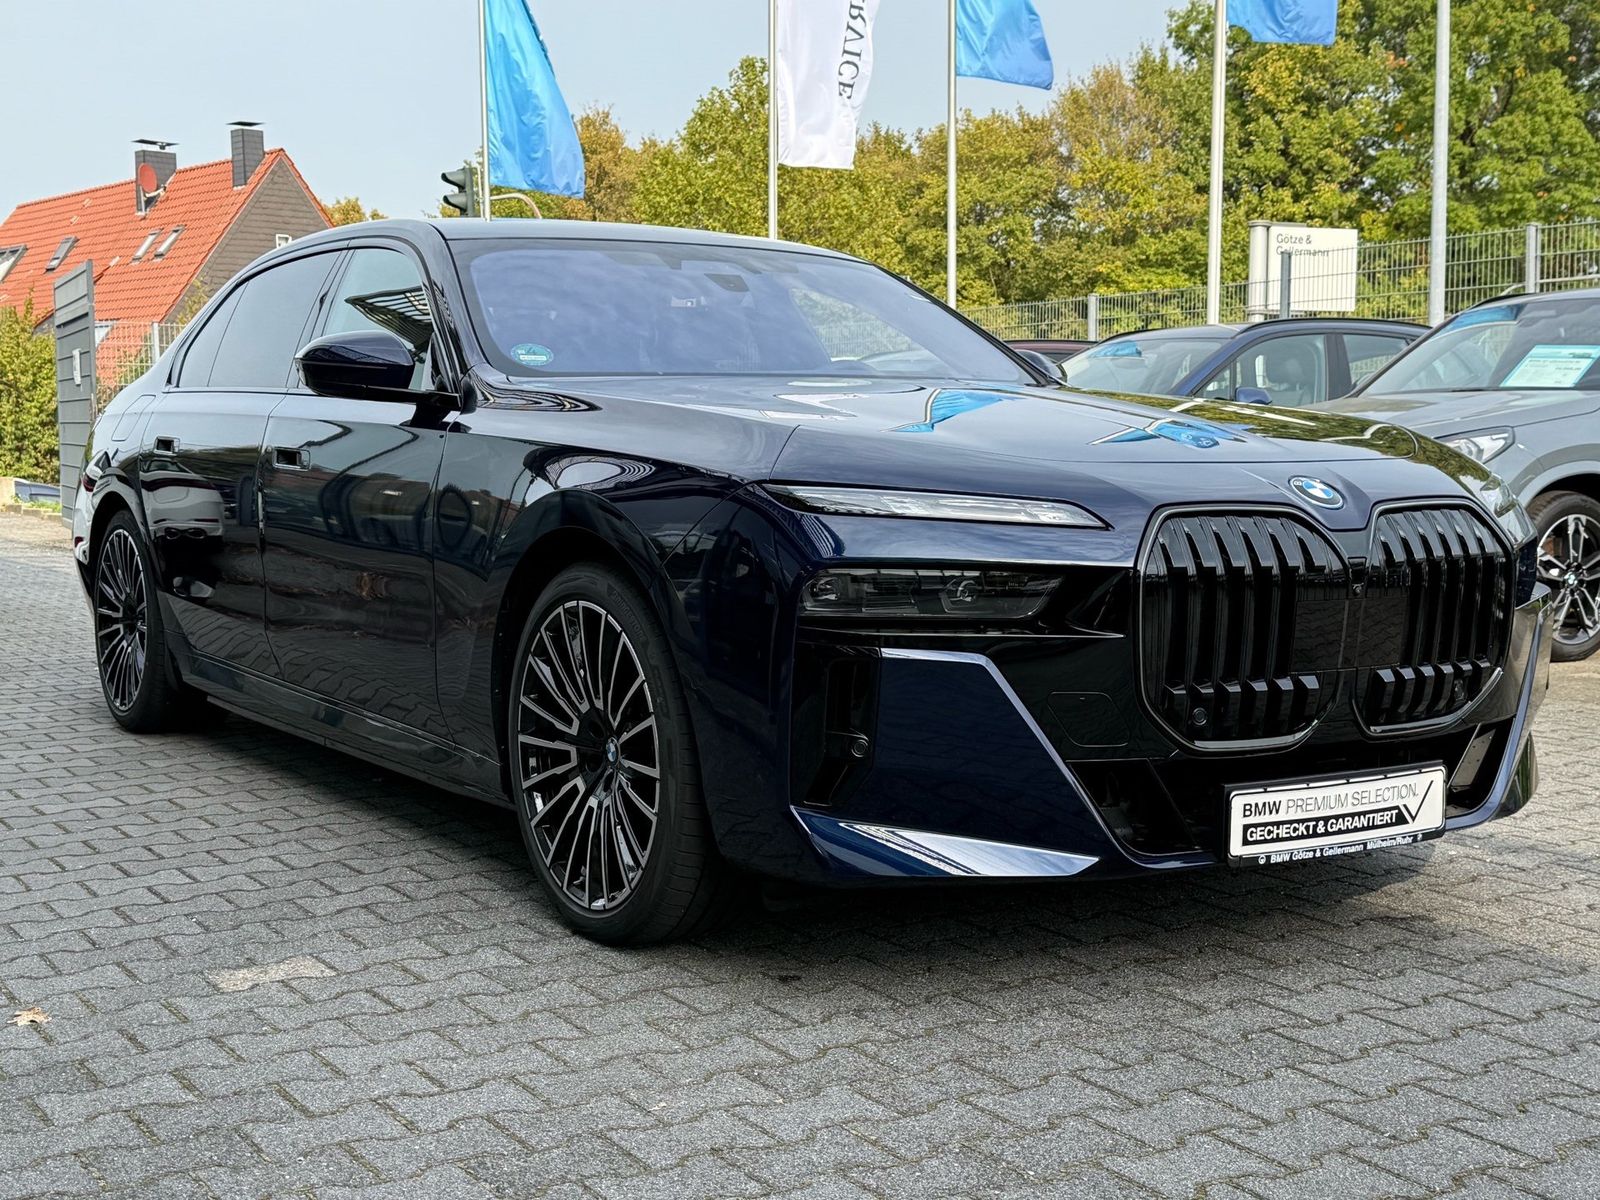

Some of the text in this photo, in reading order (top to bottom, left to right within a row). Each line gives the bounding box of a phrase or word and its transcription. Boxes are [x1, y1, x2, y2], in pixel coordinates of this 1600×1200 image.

[1276, 233, 1312, 244] Götze &
[1242, 800, 1282, 818] BMW
[1286, 791, 1349, 814] PREMIUM
[1246, 809, 1399, 842] GECHECKT & GARANTIERT
[1270, 853, 1290, 864] BMW
[1292, 849, 1314, 861] Götze
[1315, 848, 1321, 858] &
[1323, 843, 1364, 857] Gellermann
